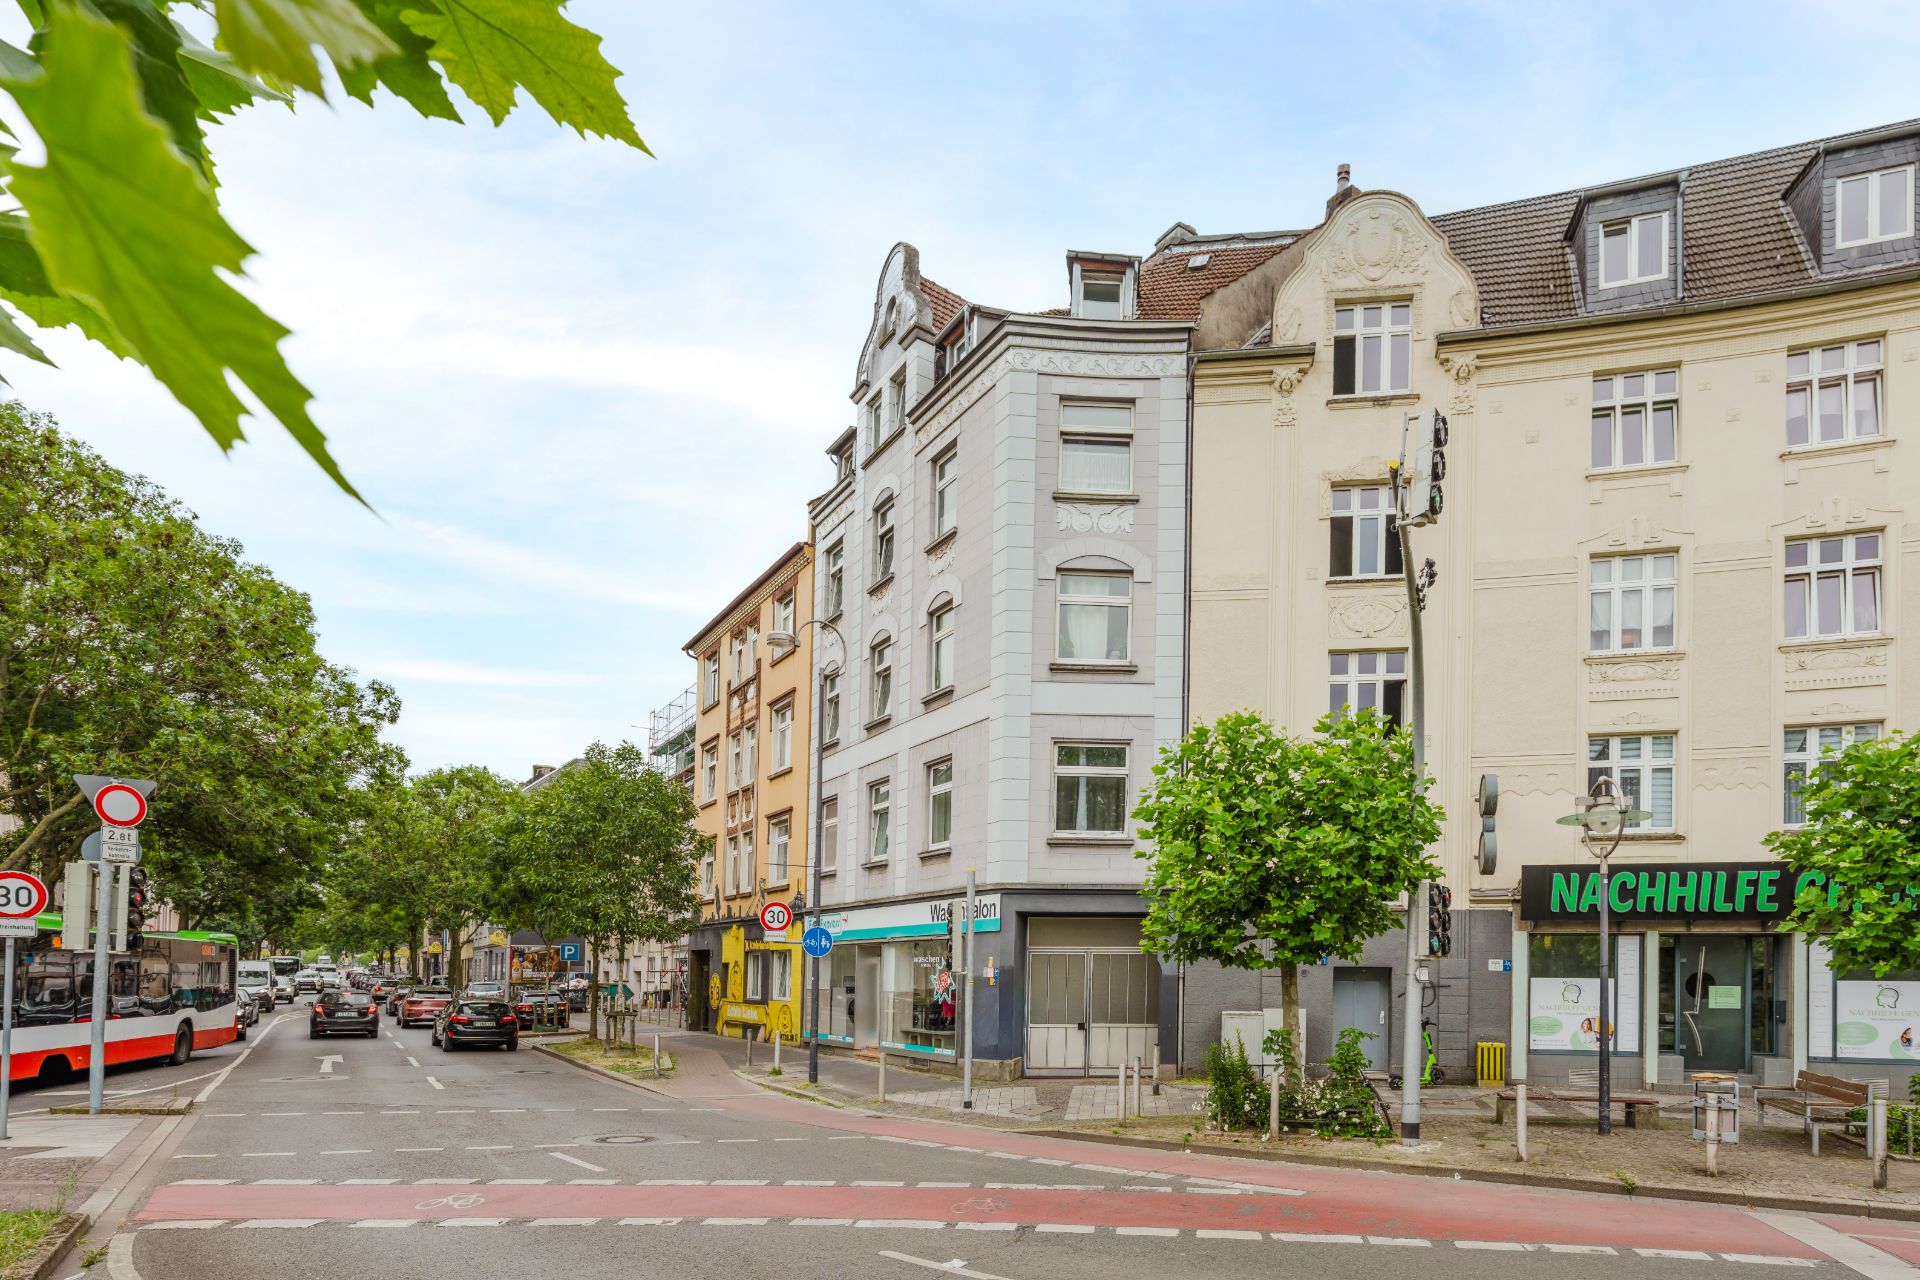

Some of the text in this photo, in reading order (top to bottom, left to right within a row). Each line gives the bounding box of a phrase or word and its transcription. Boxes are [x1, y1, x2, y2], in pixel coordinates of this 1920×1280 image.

[0, 885, 32, 907] 30
[1551, 871, 1781, 912] NACHHILFE
[767, 910, 785, 924] 30
[564, 945, 575, 959] P
